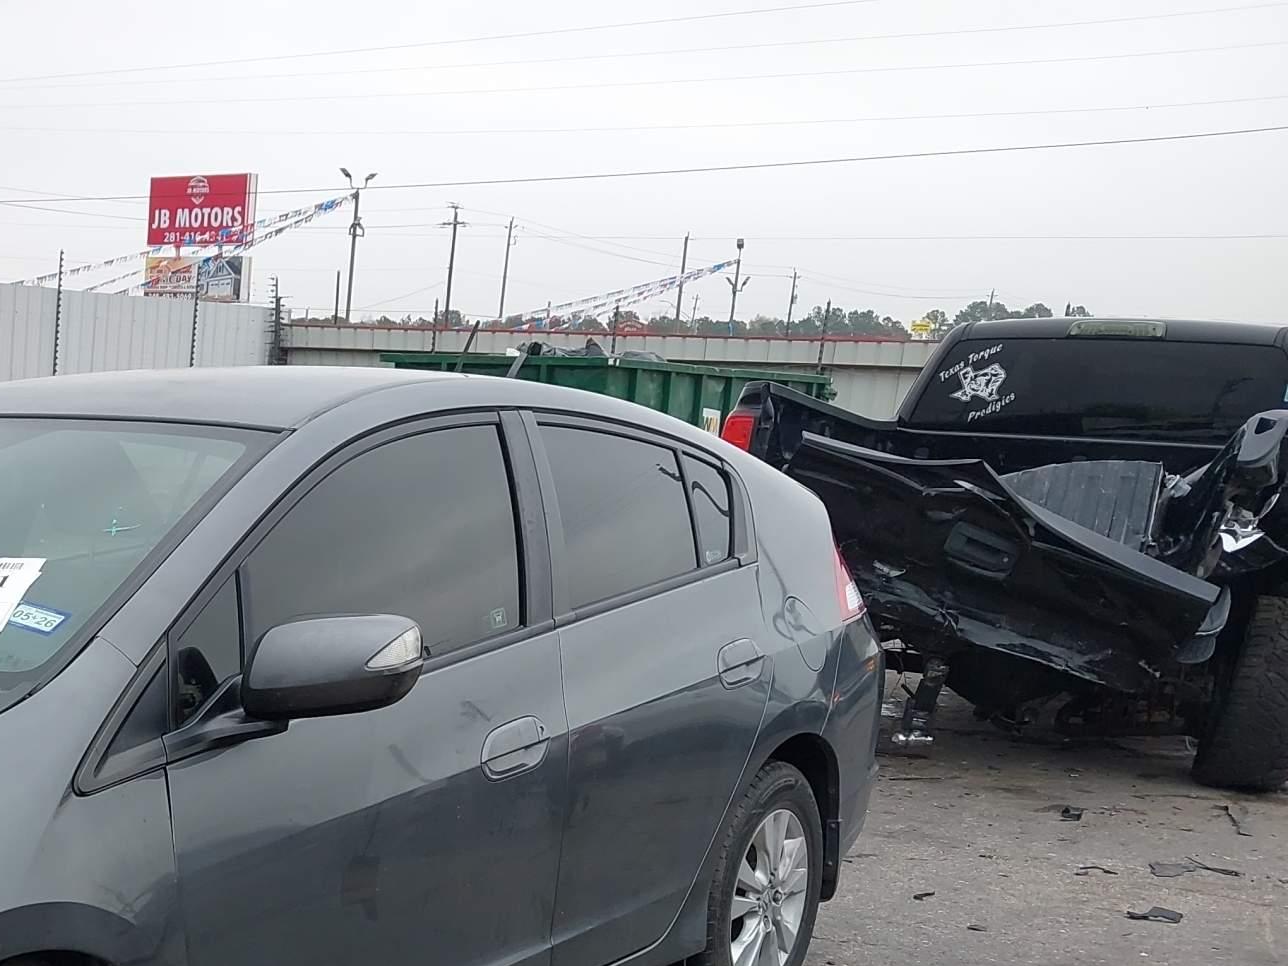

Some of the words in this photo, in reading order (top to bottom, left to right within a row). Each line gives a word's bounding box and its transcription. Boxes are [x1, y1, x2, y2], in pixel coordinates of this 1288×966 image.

[152, 209, 170, 229] JB
[175, 206, 243, 228] MOTORS
[938, 360, 965, 383] Texas
[967, 342, 1003, 365] Torque
[967, 392, 1016, 423] Prodigies
